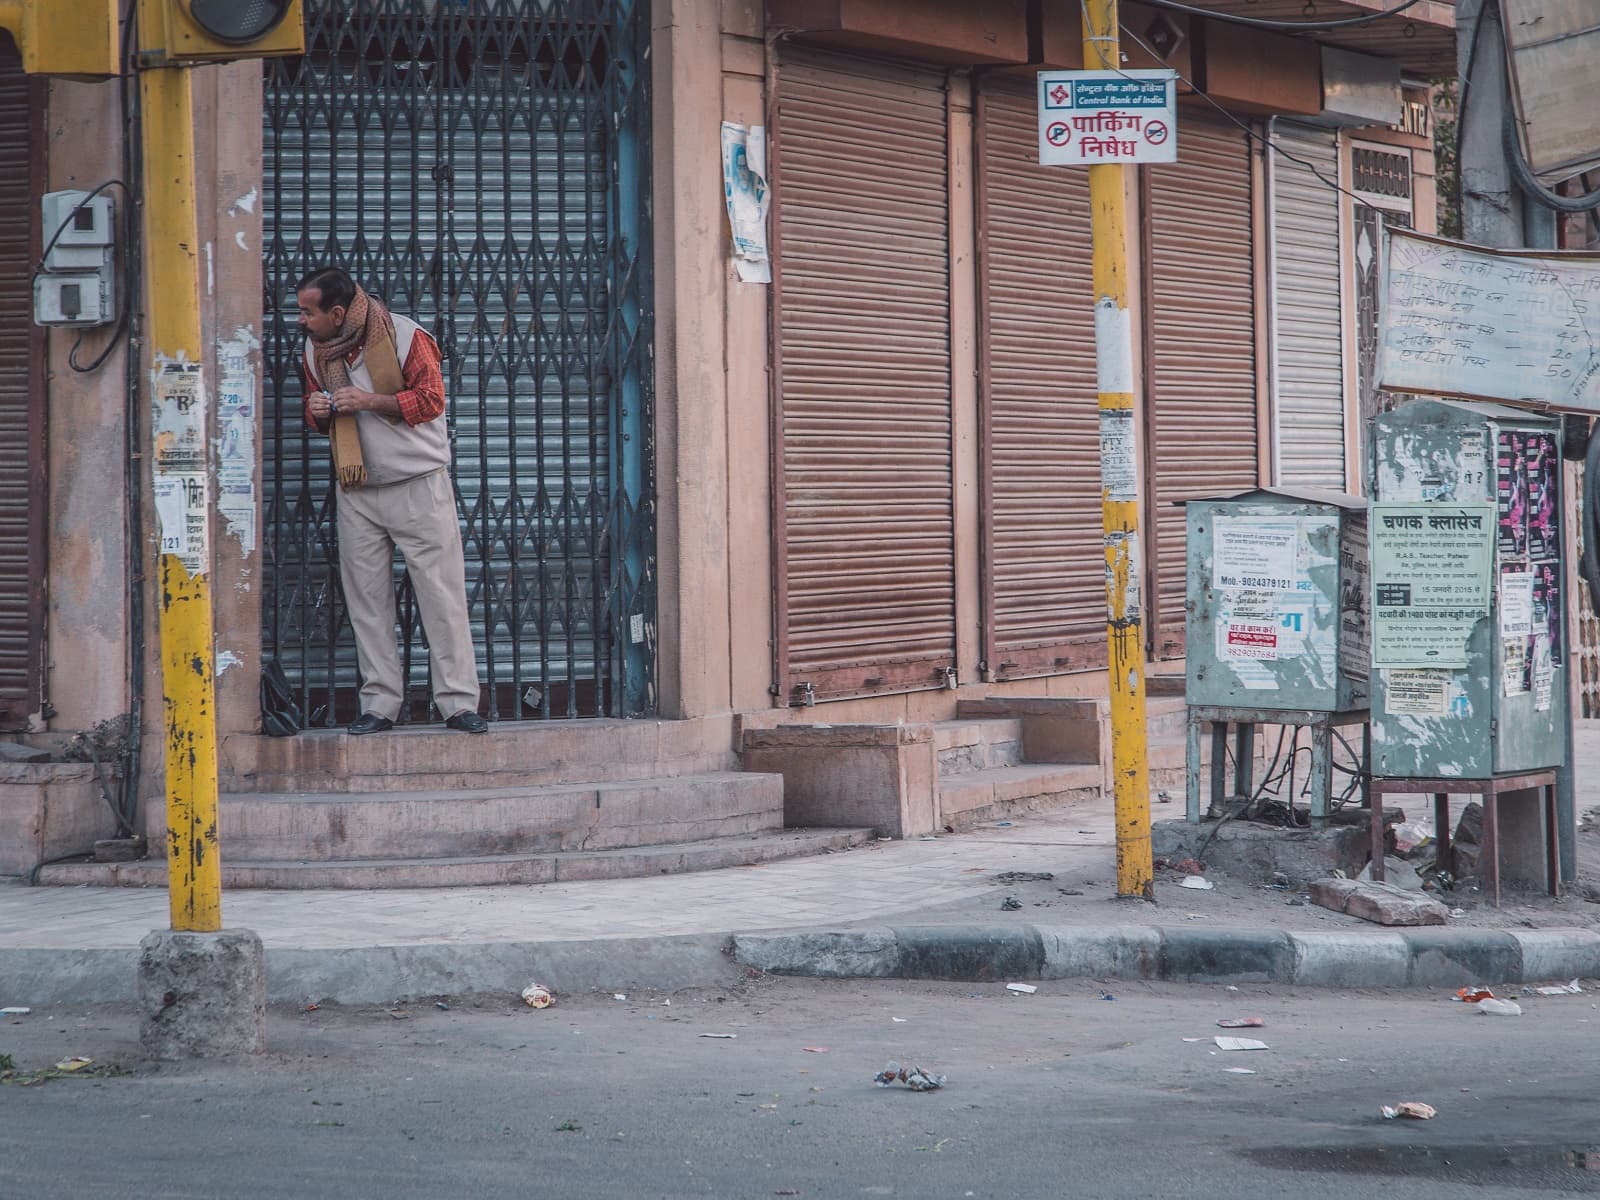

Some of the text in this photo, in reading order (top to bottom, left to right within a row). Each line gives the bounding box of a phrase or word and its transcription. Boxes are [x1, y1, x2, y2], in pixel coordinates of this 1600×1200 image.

[1078, 95, 1164, 105] Central Bank of India
[1071, 111, 1142, 132] पार्किंग
[1078, 136, 1137, 157] निषेध
[1565, 317, 1579, 328] 2
[1556, 331, 1579, 346] 40
[1550, 348, 1572, 359] 20
[1543, 364, 1571, 378] 50
[1382, 511, 1482, 530] चणक क्लासेज
[1431, 584, 1452, 593] जनवरी
